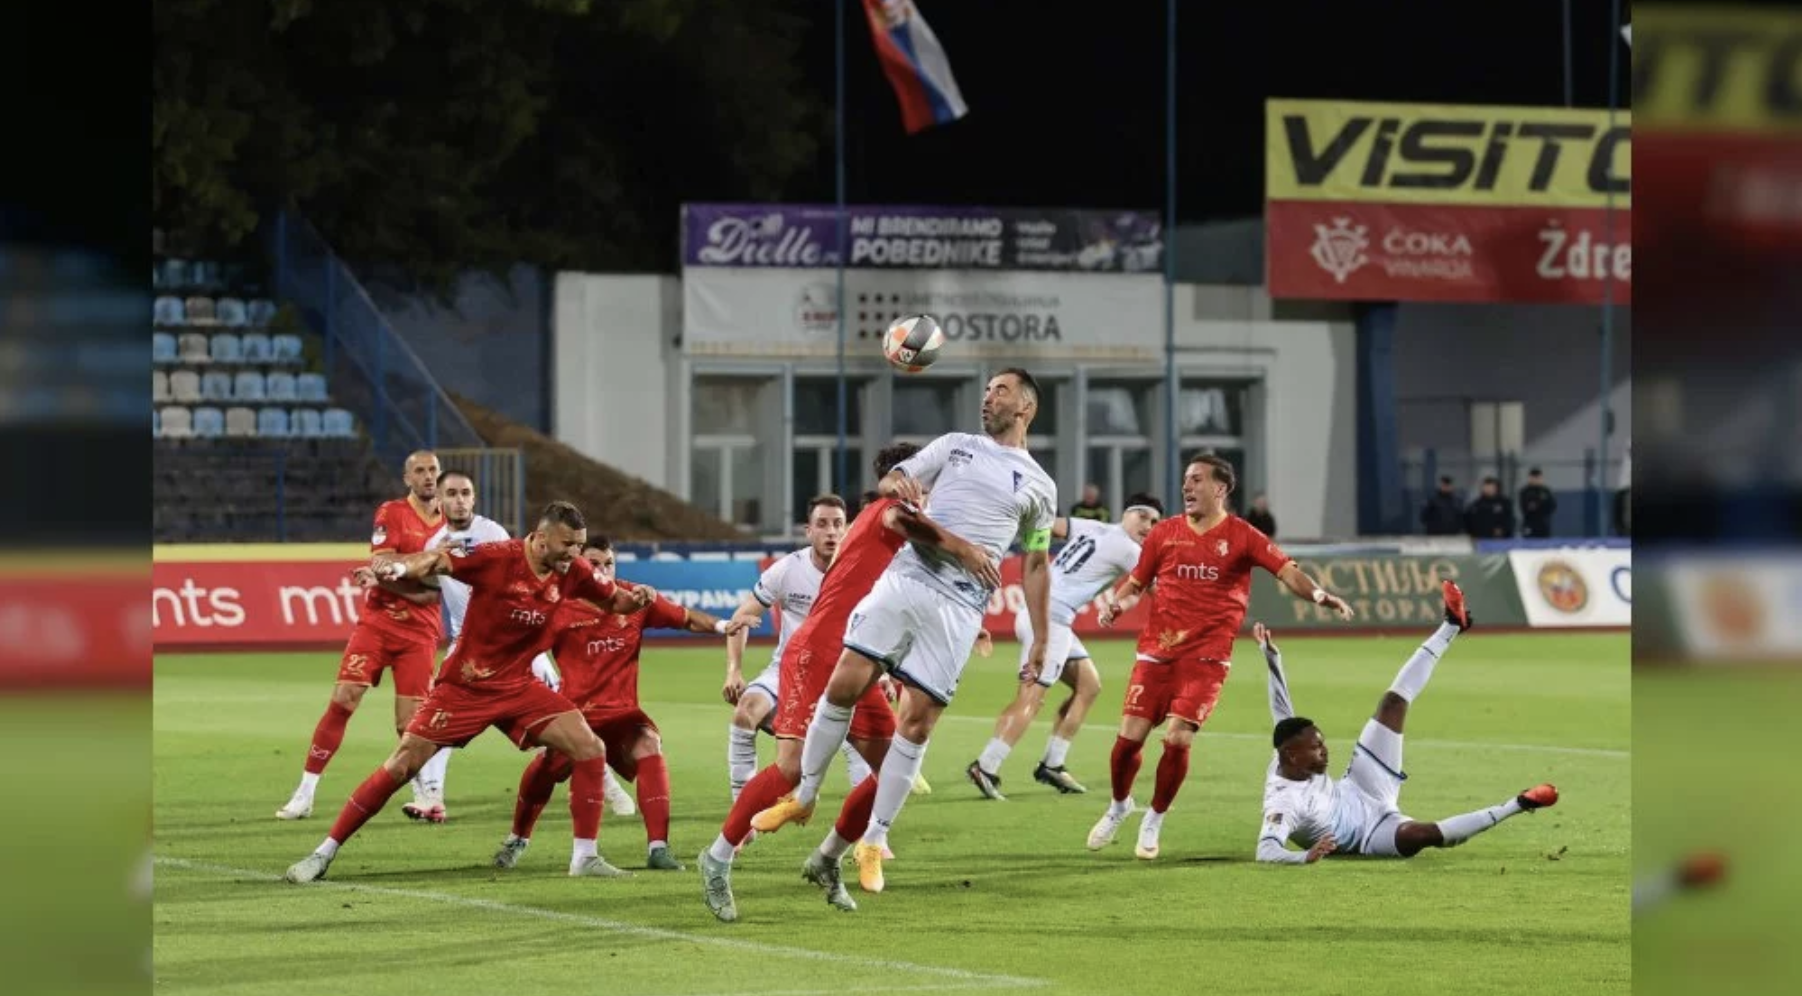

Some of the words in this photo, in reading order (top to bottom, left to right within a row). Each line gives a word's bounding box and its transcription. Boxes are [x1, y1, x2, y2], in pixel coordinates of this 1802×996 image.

[852, 237, 1003, 265] POBEDNIKE
[934, 312, 1063, 342] OSTORA
[1176, 562, 1219, 581] mts
[279, 577, 363, 626] mt
[587, 636, 625, 656] mts
